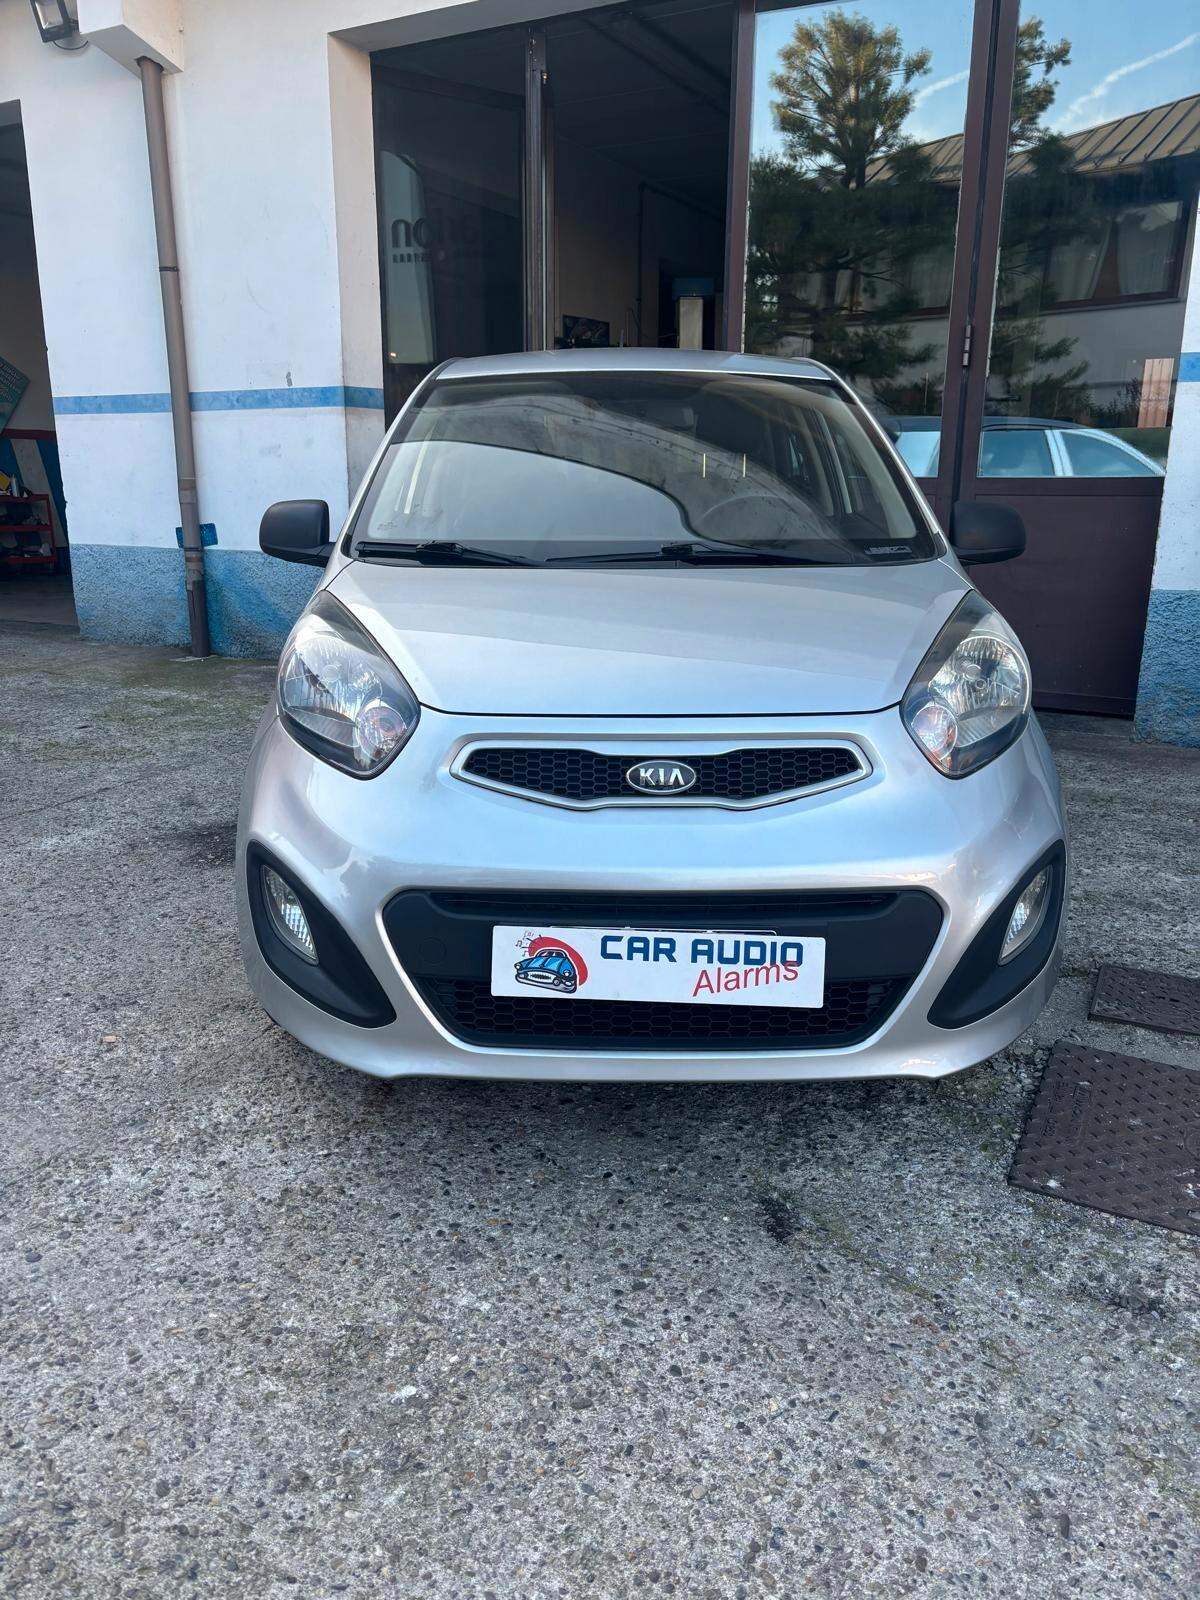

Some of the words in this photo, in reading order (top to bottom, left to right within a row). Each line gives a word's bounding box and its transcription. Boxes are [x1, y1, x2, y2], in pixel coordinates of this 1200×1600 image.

[639, 768, 685, 786] KIA
[600, 935, 677, 963] CAR
[690, 938, 804, 967] AUDIO
[692, 960, 799, 997] Alarms
